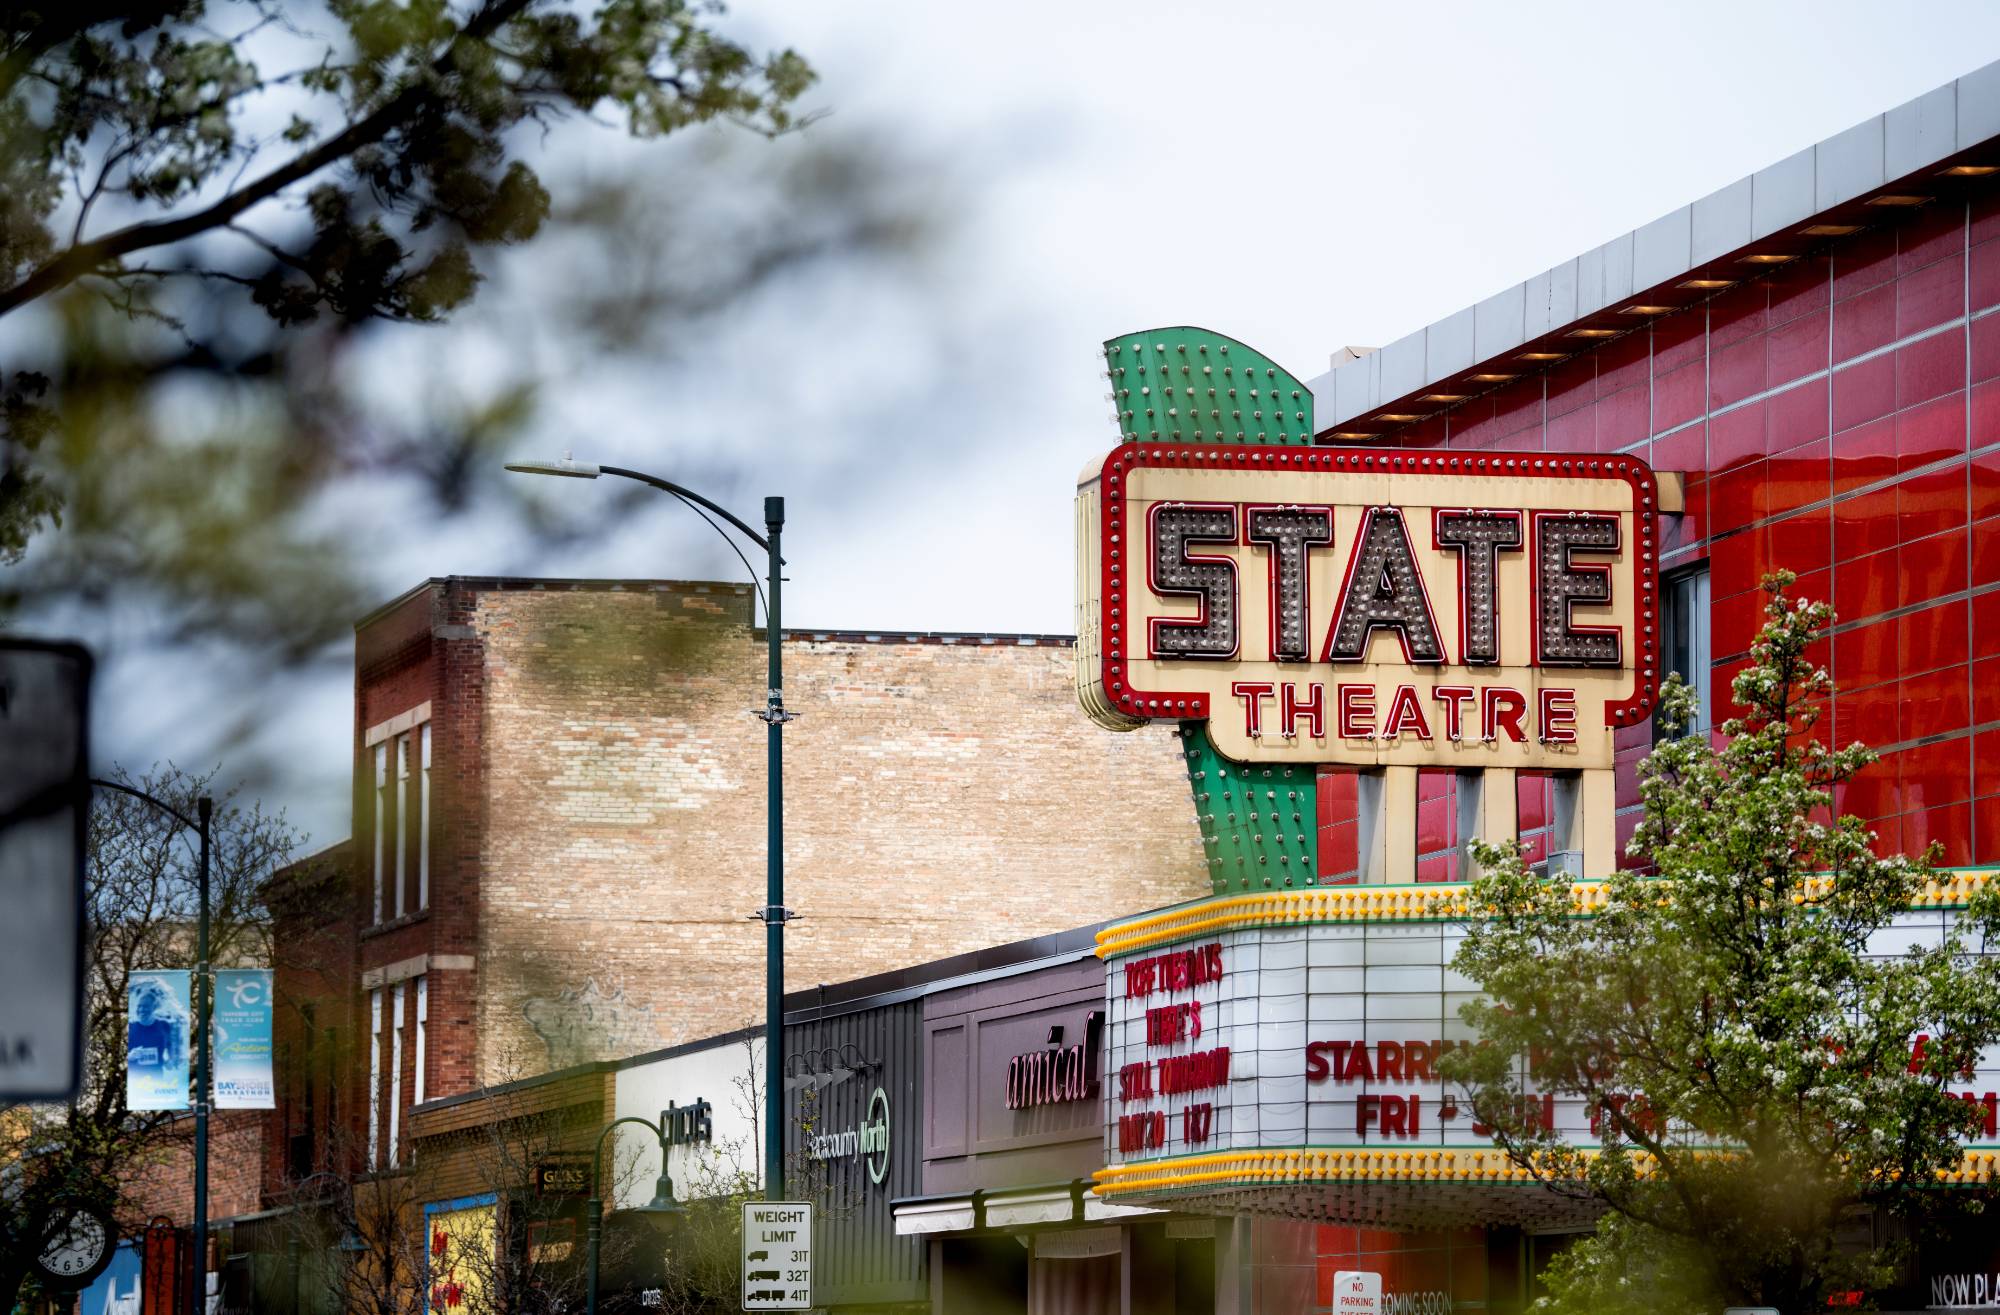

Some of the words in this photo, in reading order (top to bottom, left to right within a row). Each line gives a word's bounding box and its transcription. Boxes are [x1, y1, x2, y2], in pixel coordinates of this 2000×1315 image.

[1147, 501, 1623, 667] STATE
[1232, 681, 1577, 743] THEATRE
[1157, 943, 1223, 992] TUESDAYS
[1146, 1001, 1201, 1046] THERE'S
[1005, 1011, 1104, 1109] amical
[1119, 1060, 1154, 1102] STILL
[1158, 1047, 1229, 1095] TOMORROW
[1356, 1094, 1420, 1135] FRI
[860, 1118, 886, 1154] North
[754, 1211, 805, 1223] WEIGHT
[762, 1231, 796, 1242] LIMIT
[791, 1250, 808, 1262] 31T
[786, 1270, 808, 1282] 32T
[1352, 1282, 1364, 1292] NO
[1931, 1273, 1970, 1306] NOW
[791, 1289, 808, 1301] 41T
[1340, 1296, 1374, 1307] PARKING
[1423, 1290, 1452, 1315] SOON
